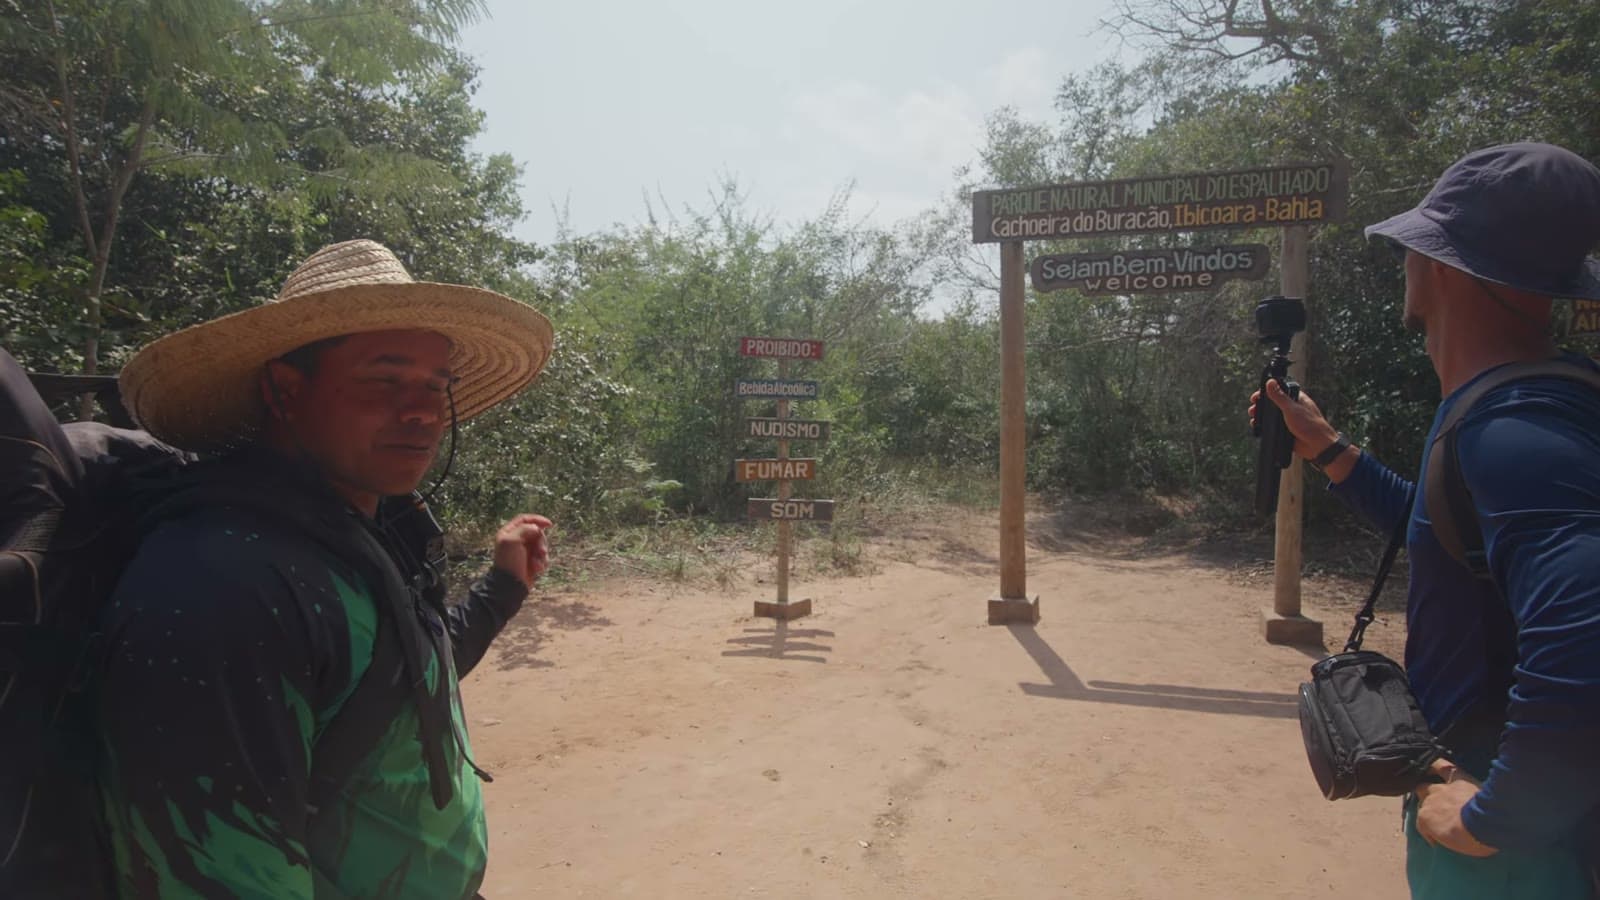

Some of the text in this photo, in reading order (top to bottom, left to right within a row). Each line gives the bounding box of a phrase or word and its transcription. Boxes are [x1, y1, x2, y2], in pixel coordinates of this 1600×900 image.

[991, 189, 1048, 216] PARQUE
[1050, 185, 1121, 212] NATURAL
[1124, 178, 1203, 206] MUNICIPAL
[1229, 167, 1329, 199] ESPALHADO
[991, 215, 1070, 237] Cachoeira
[1072, 211, 1094, 233] do
[1042, 259, 1110, 280] Sejam
[1085, 273, 1212, 290] welcome
[747, 339, 817, 357] PROIBIDO:
[751, 421, 820, 438] NUDISMO
[745, 462, 808, 479] FUMAR
[771, 502, 814, 518] SOM
